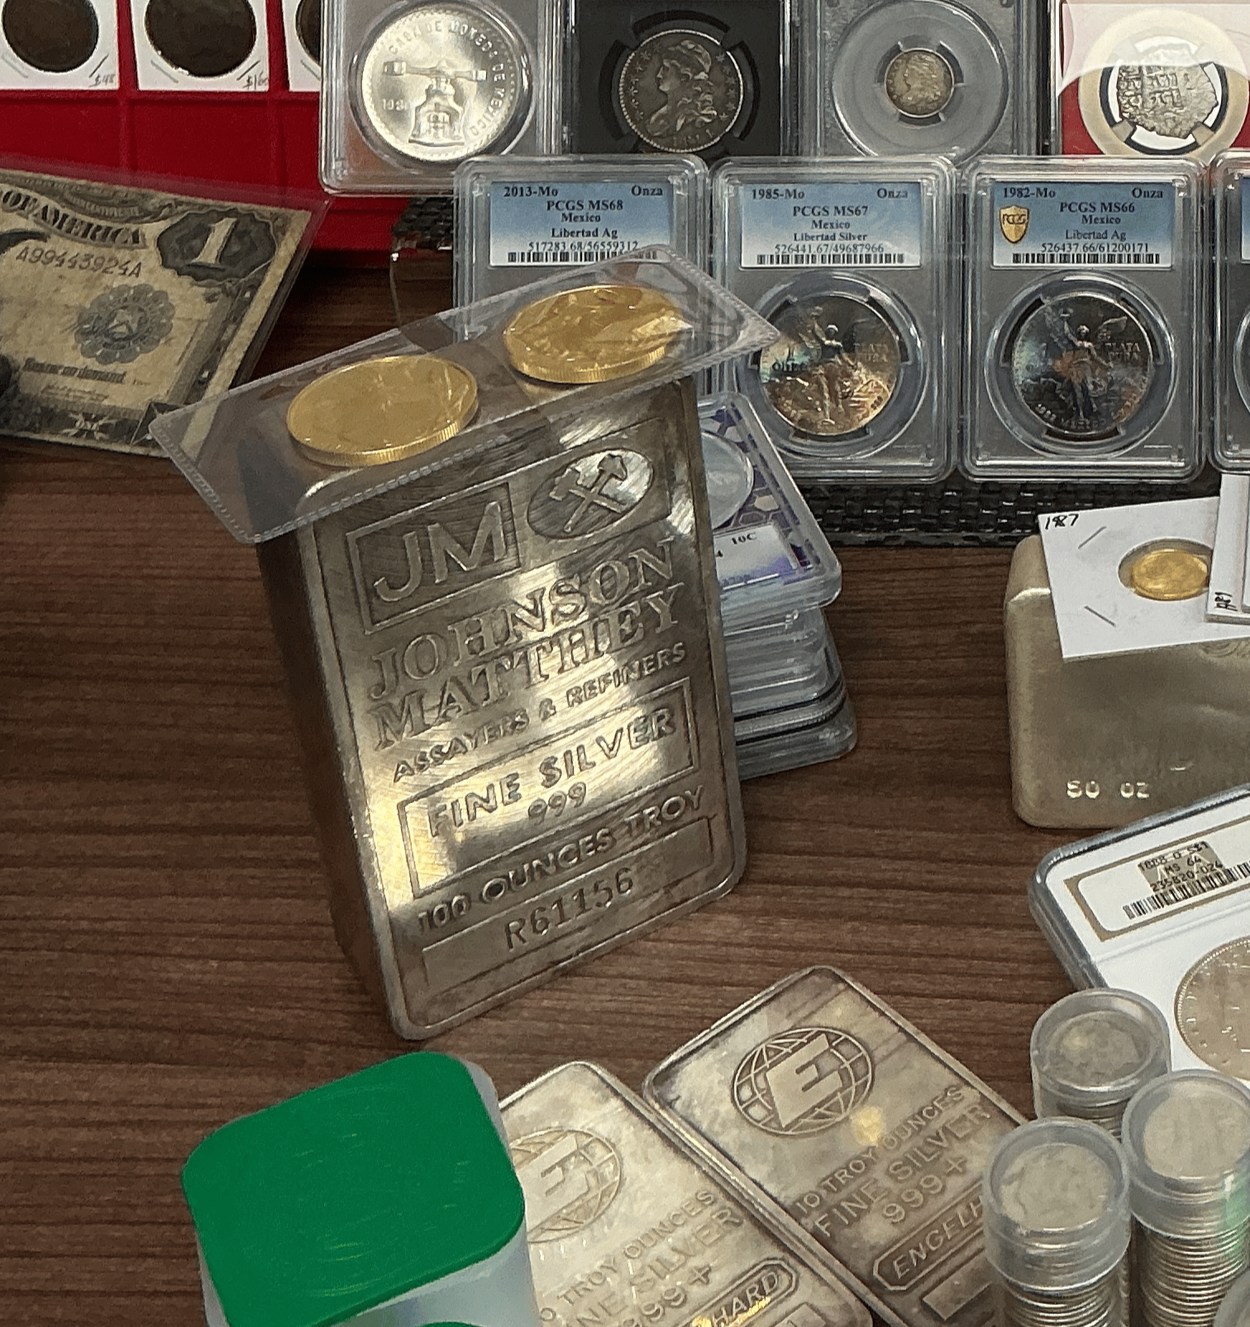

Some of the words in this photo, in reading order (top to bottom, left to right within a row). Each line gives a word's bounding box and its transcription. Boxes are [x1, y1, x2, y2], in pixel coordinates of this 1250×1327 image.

[503, 186, 559, 198] 2013-Mo
[631, 185, 664, 197] Onza
[546, 199, 585, 211] PCGS
[588, 199, 623, 211] MS68
[751, 188, 805, 200] 1985-Mo
[877, 187, 909, 199] Onza
[1003, 187, 1057, 198] 1982-Mo
[1131, 186, 1164, 198] Onza
[33, 198, 142, 245] AMERICA
[560, 213, 601, 223] Mexico
[792, 205, 831, 217] PCGS
[833, 205, 869, 217] MS67
[1059, 201, 1097, 213] PCGS
[1099, 201, 1136, 213] MS66
[1081, 214, 1122, 225] Mexico
[551, 227, 599, 239] Libertad
[793, 232, 837, 242] Libertad
[838, 232, 868, 242] Silver
[810, 219, 851, 230] Mexico
[373, 501, 505, 604] JM
[368, 534, 676, 702] JOHNSON
[366, 580, 686, 752] MATTHEY
[393, 705, 531, 784] ASSAYERS
[566, 641, 687, 707] REFINERS
[428, 770, 522, 839] FINE
[538, 705, 676, 785] SILVER
[418, 893, 472, 931] 100
[479, 827, 617, 904] OUNCES
[625, 785, 705, 834] TROY
[503, 866, 635, 952] R61156
[817, 1144, 879, 1198] TROY
[881, 1082, 966, 1152] OUNCES
[814, 1178, 888, 1238] FINE
[888, 1102, 992, 1183] SILVER
[623, 1189, 717, 1260] OUNCES
